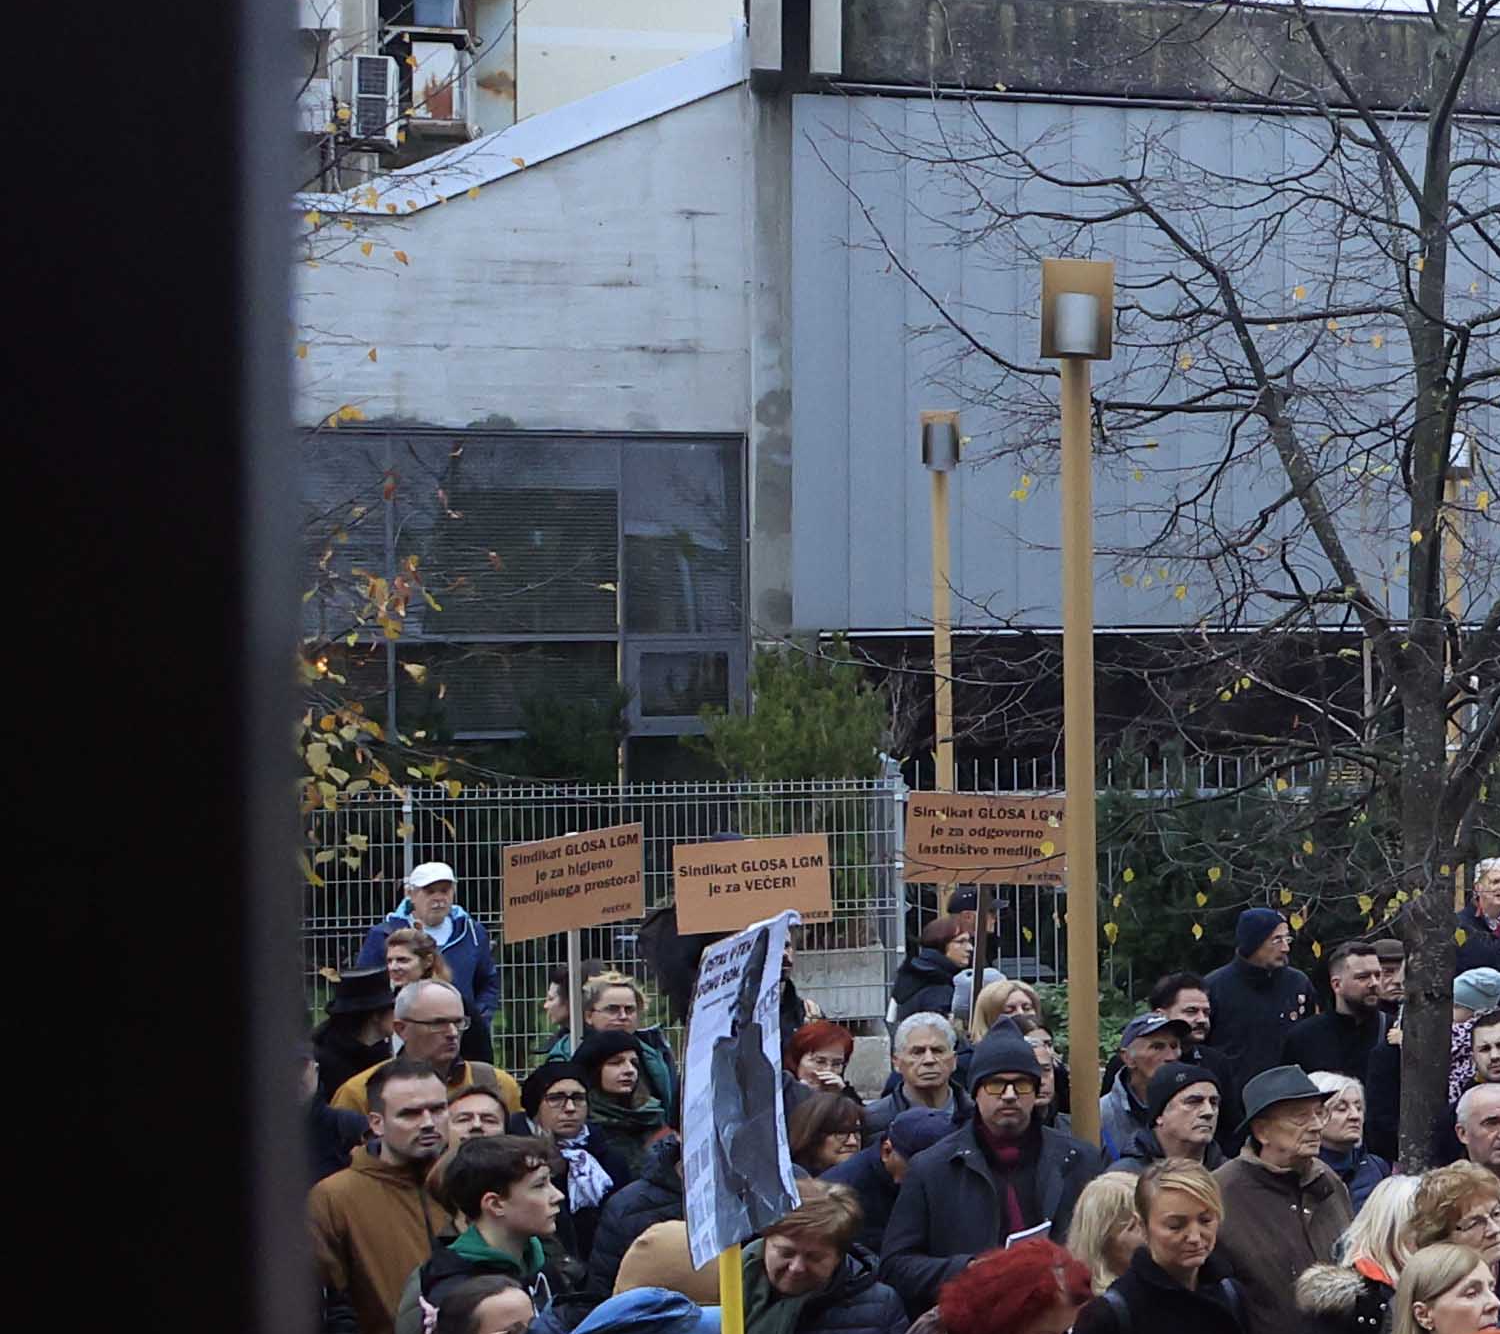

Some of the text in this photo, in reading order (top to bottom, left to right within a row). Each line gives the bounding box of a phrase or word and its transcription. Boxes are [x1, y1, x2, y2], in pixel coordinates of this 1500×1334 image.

[978, 807, 1026, 820] GLOSA
[930, 824, 1044, 840] je za odgovorno
[511, 833, 639, 867] Sindikat GLOSA LGM
[918, 842, 1045, 859] lastništvo medije
[535, 859, 613, 885] je za higieno
[679, 855, 823, 877] Sindikat GLOSA LGM
[509, 870, 640, 907] medijskega prostora!
[708, 874, 796, 897] je za VEČER!
